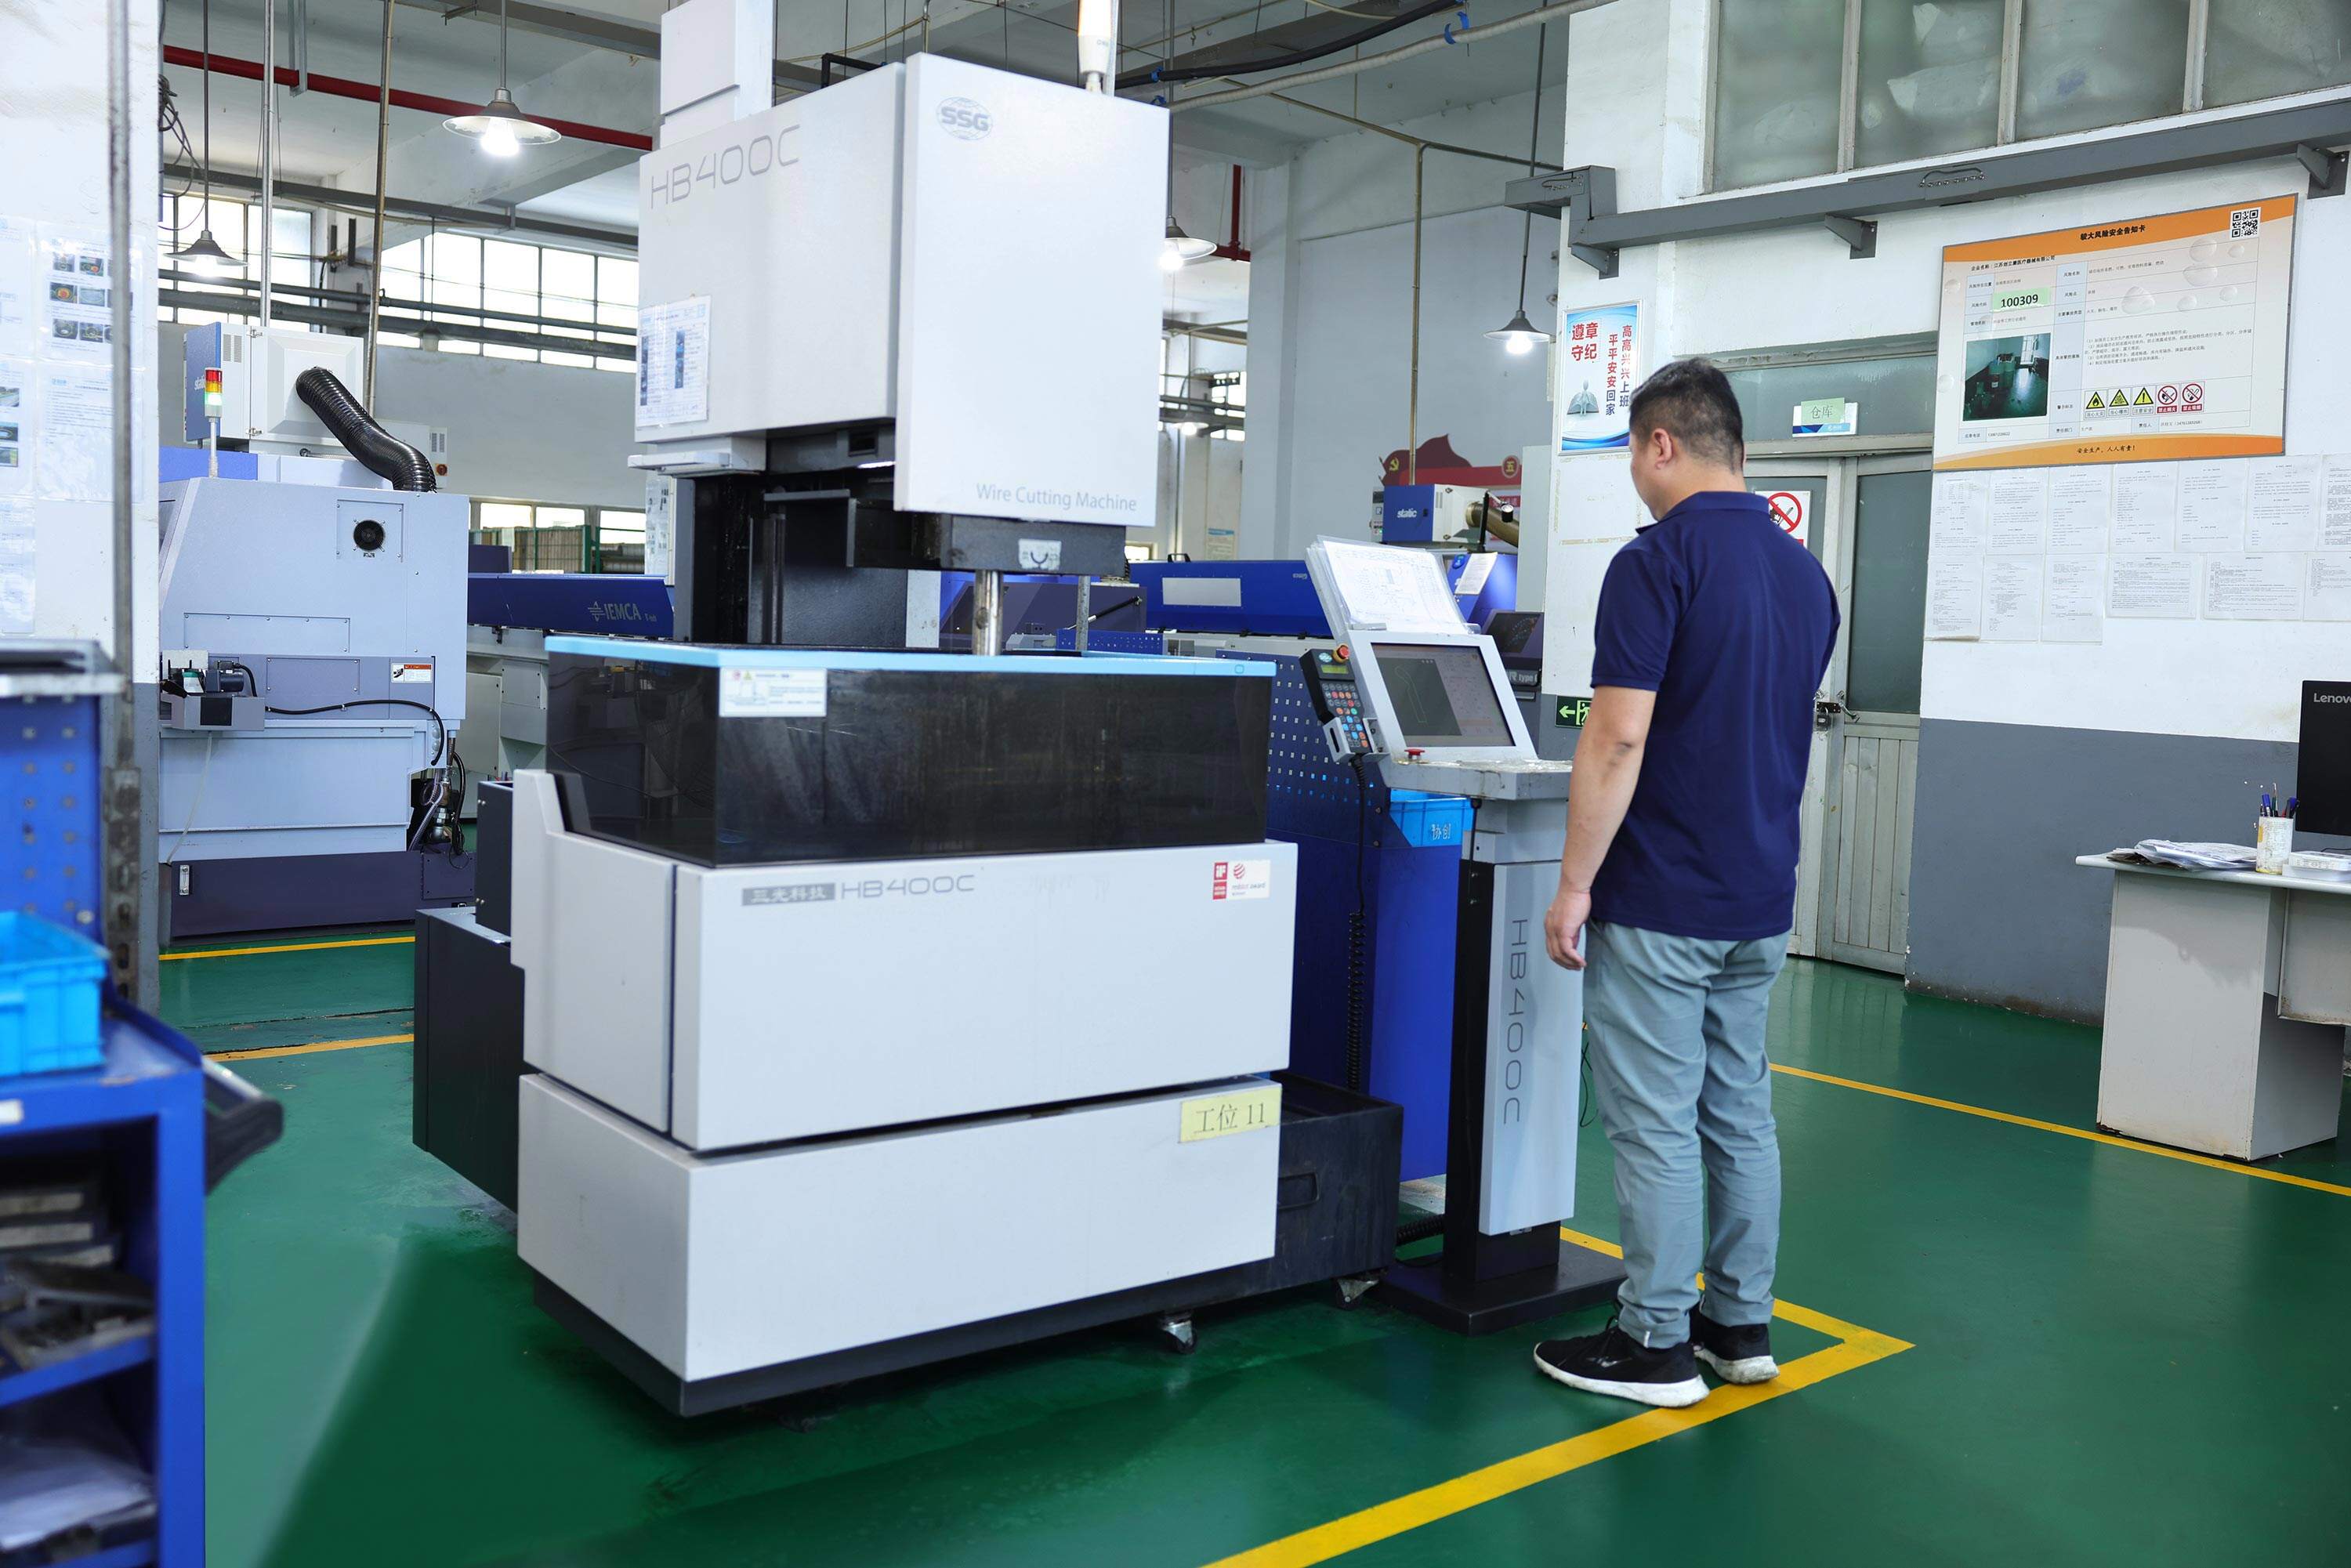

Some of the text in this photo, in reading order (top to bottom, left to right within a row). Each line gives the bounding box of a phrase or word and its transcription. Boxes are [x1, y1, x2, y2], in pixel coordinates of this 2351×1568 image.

[941, 106, 989, 132] SSG
[650, 124, 801, 210] HB400C
[2080, 224, 2146, 241] 较大风险安全告知卡
[2000, 293, 2038, 308] 100309
[1571, 321, 1599, 341] 遵章
[1570, 343, 1597, 361] 守纪
[1606, 333, 1618, 416] 平平安安回家
[1619, 324, 1632, 407] 高高兴兴上班
[1810, 405, 1834, 419] 仓库
[976, 483, 1137, 512] Wire Cutting Machine
[1396, 508, 1418, 519] static
[603, 603, 642, 621] IEMCA
[2313, 692, 2351, 704] Lenov
[750, 875, 975, 904] 三光科技 HB400C
[1503, 918, 1528, 1124] HB400C
[1194, 1102, 1265, 1135] 工位 11
